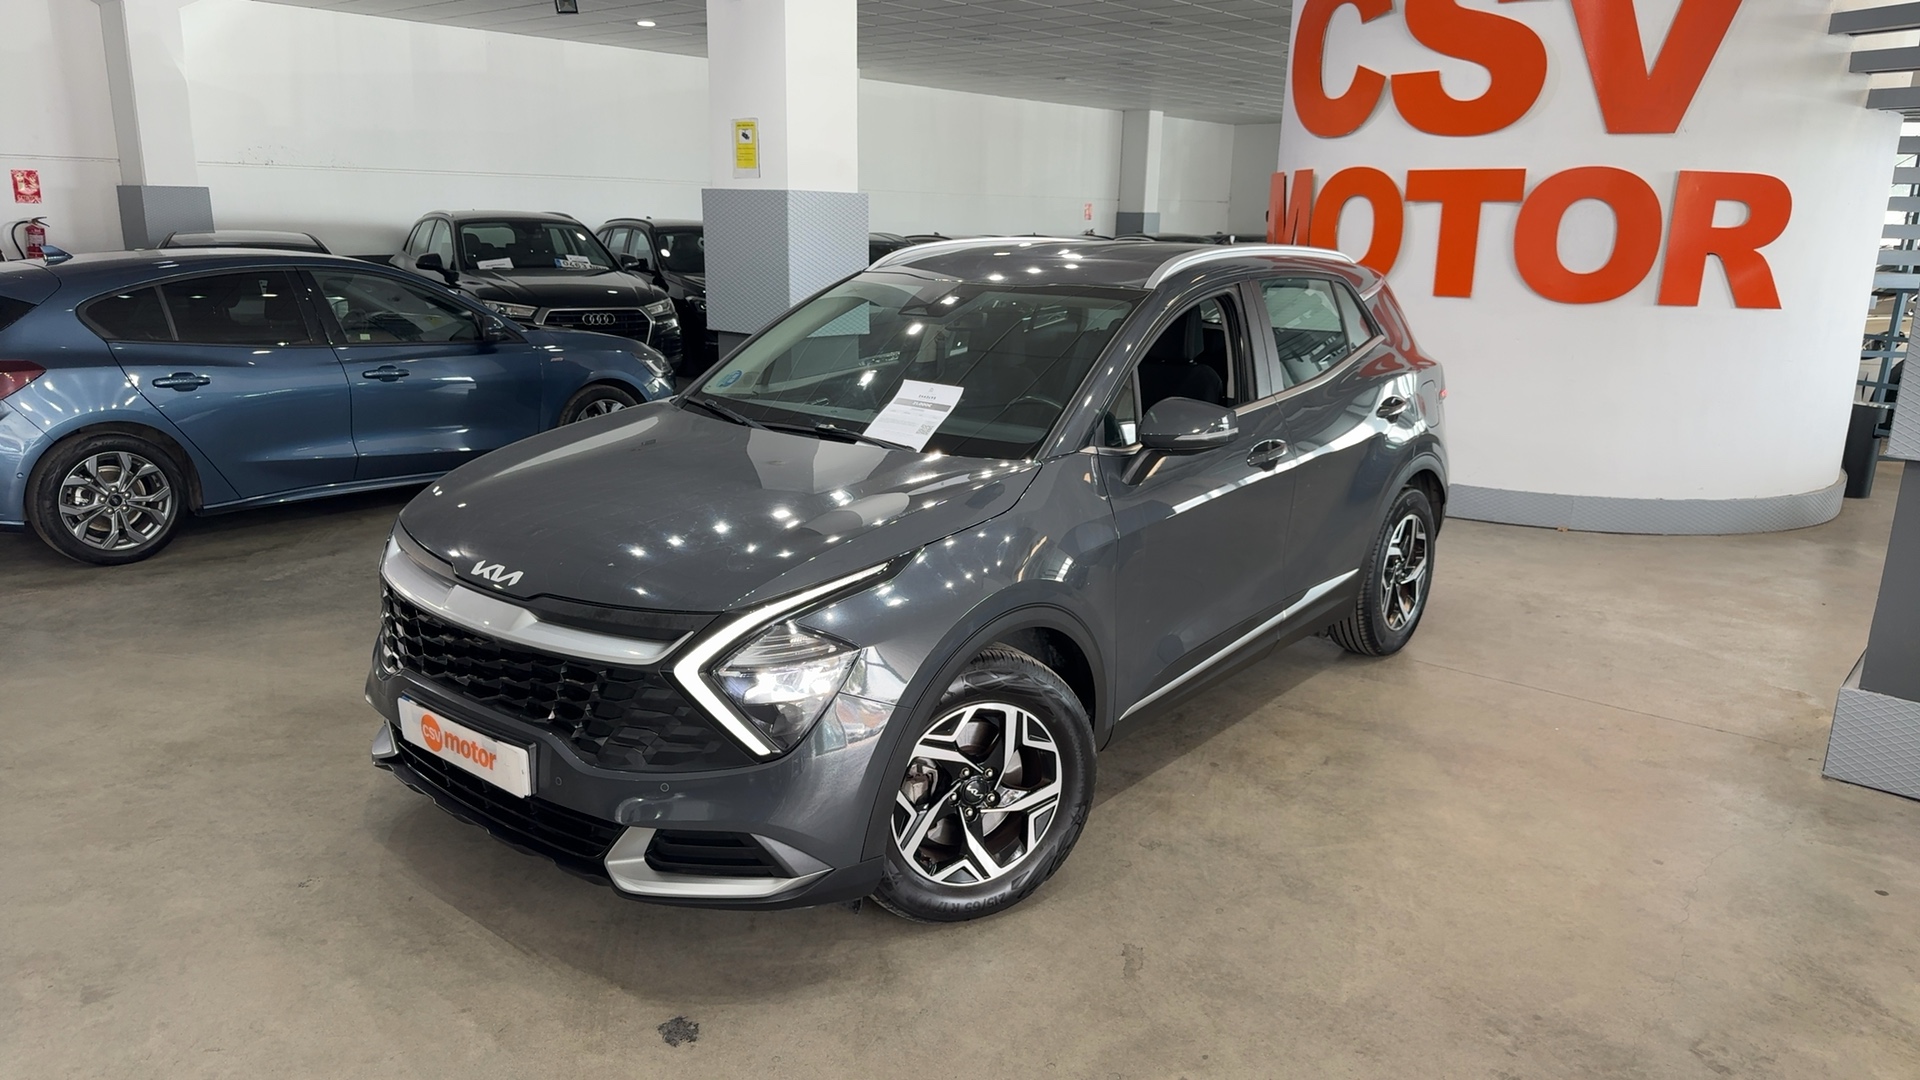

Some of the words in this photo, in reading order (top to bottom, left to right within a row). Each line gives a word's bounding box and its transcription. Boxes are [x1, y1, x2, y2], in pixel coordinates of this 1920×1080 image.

[1292, 0, 1743, 138] CSV
[1267, 165, 1793, 309] MOTOR
[471, 560, 524, 586] KIA
[422, 724, 441, 743] CSV
[444, 730, 497, 771] motor
